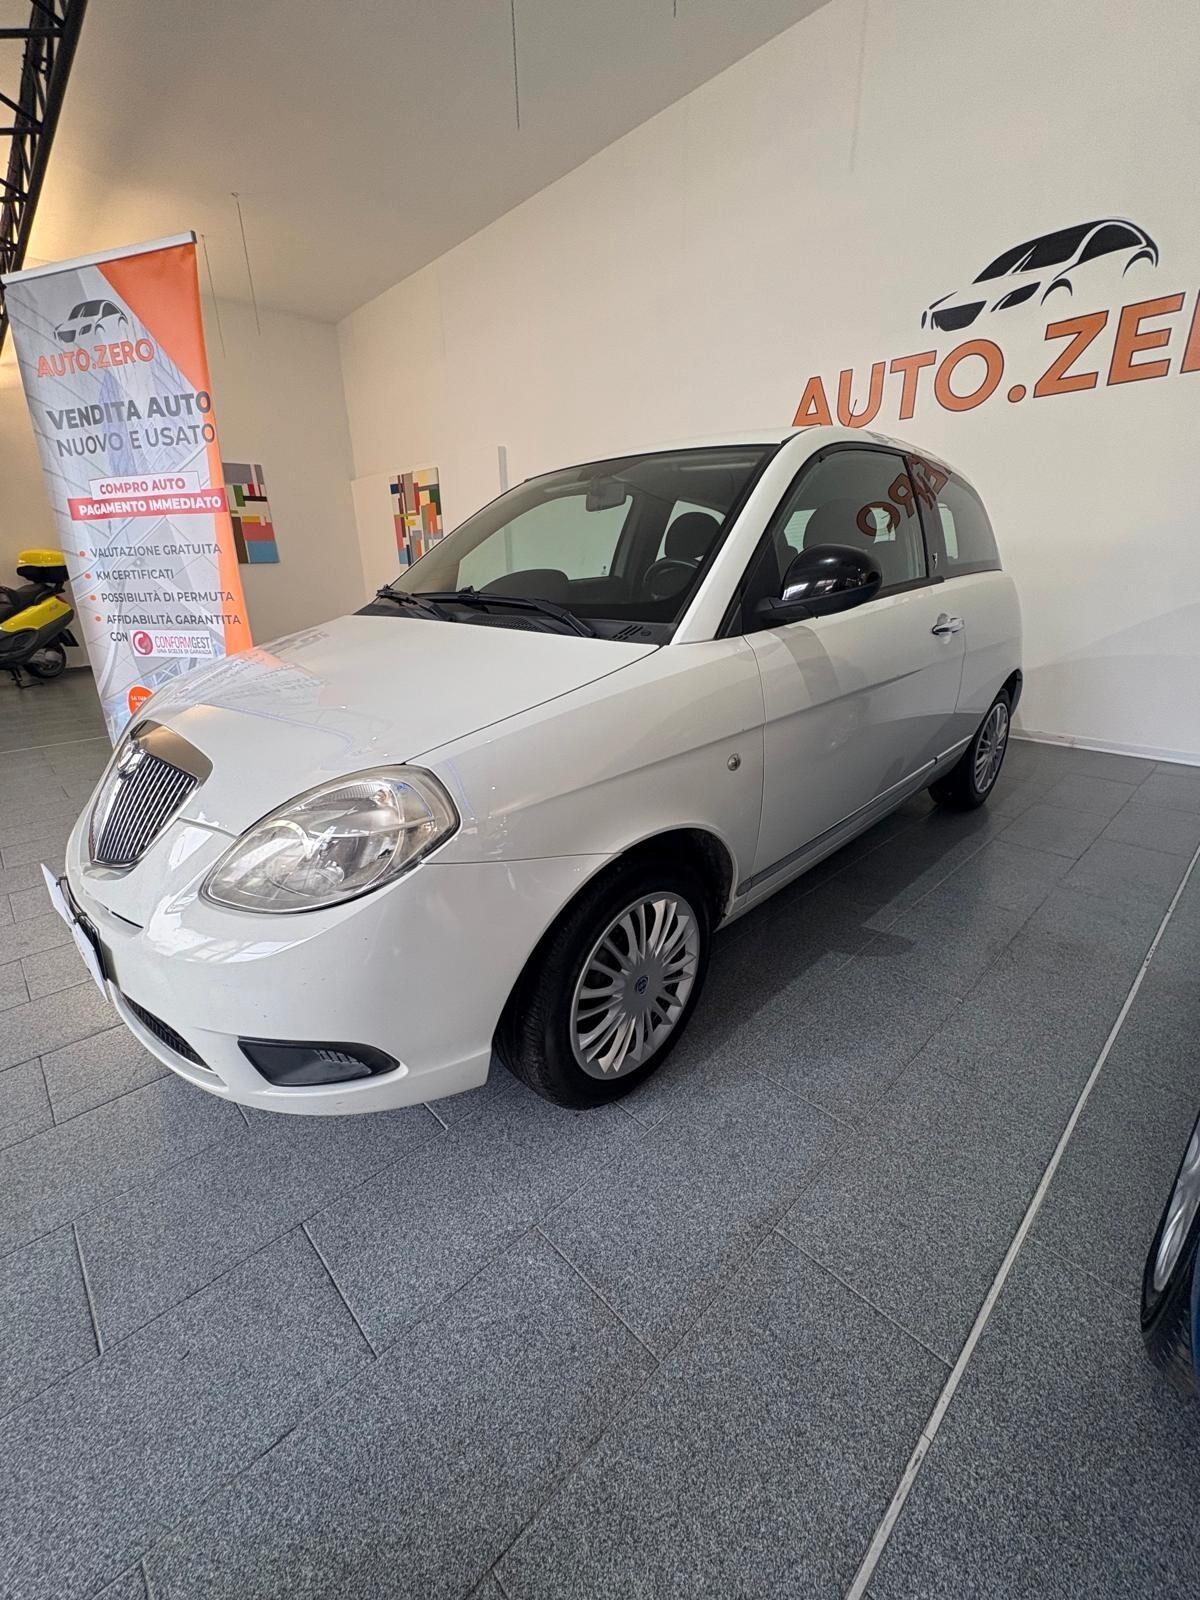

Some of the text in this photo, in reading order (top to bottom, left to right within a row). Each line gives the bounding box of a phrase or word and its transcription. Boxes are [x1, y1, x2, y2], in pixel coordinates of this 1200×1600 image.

[37, 338, 155, 378] AUTO.ZERO
[791, 288, 1200, 428] AUTO.ZE
[46, 390, 211, 430] VENDITA AUTO
[56, 423, 215, 457] NUOVO E USATO
[99, 477, 186, 495] COMPRO AUTO
[79, 496, 221, 516] PAGAMENTO IMMEDIATO
[90, 543, 222, 558] VALUTAZIONE GRATUITA
[96, 569, 174, 581] KM CERTIFICATI
[101, 590, 234, 602] POSSIBILITÀ DI PERMUTA
[107, 612, 241, 625] AFFIDABILITÀ GARANTITA
[110, 632, 210, 649] CON CONFORMGEST
